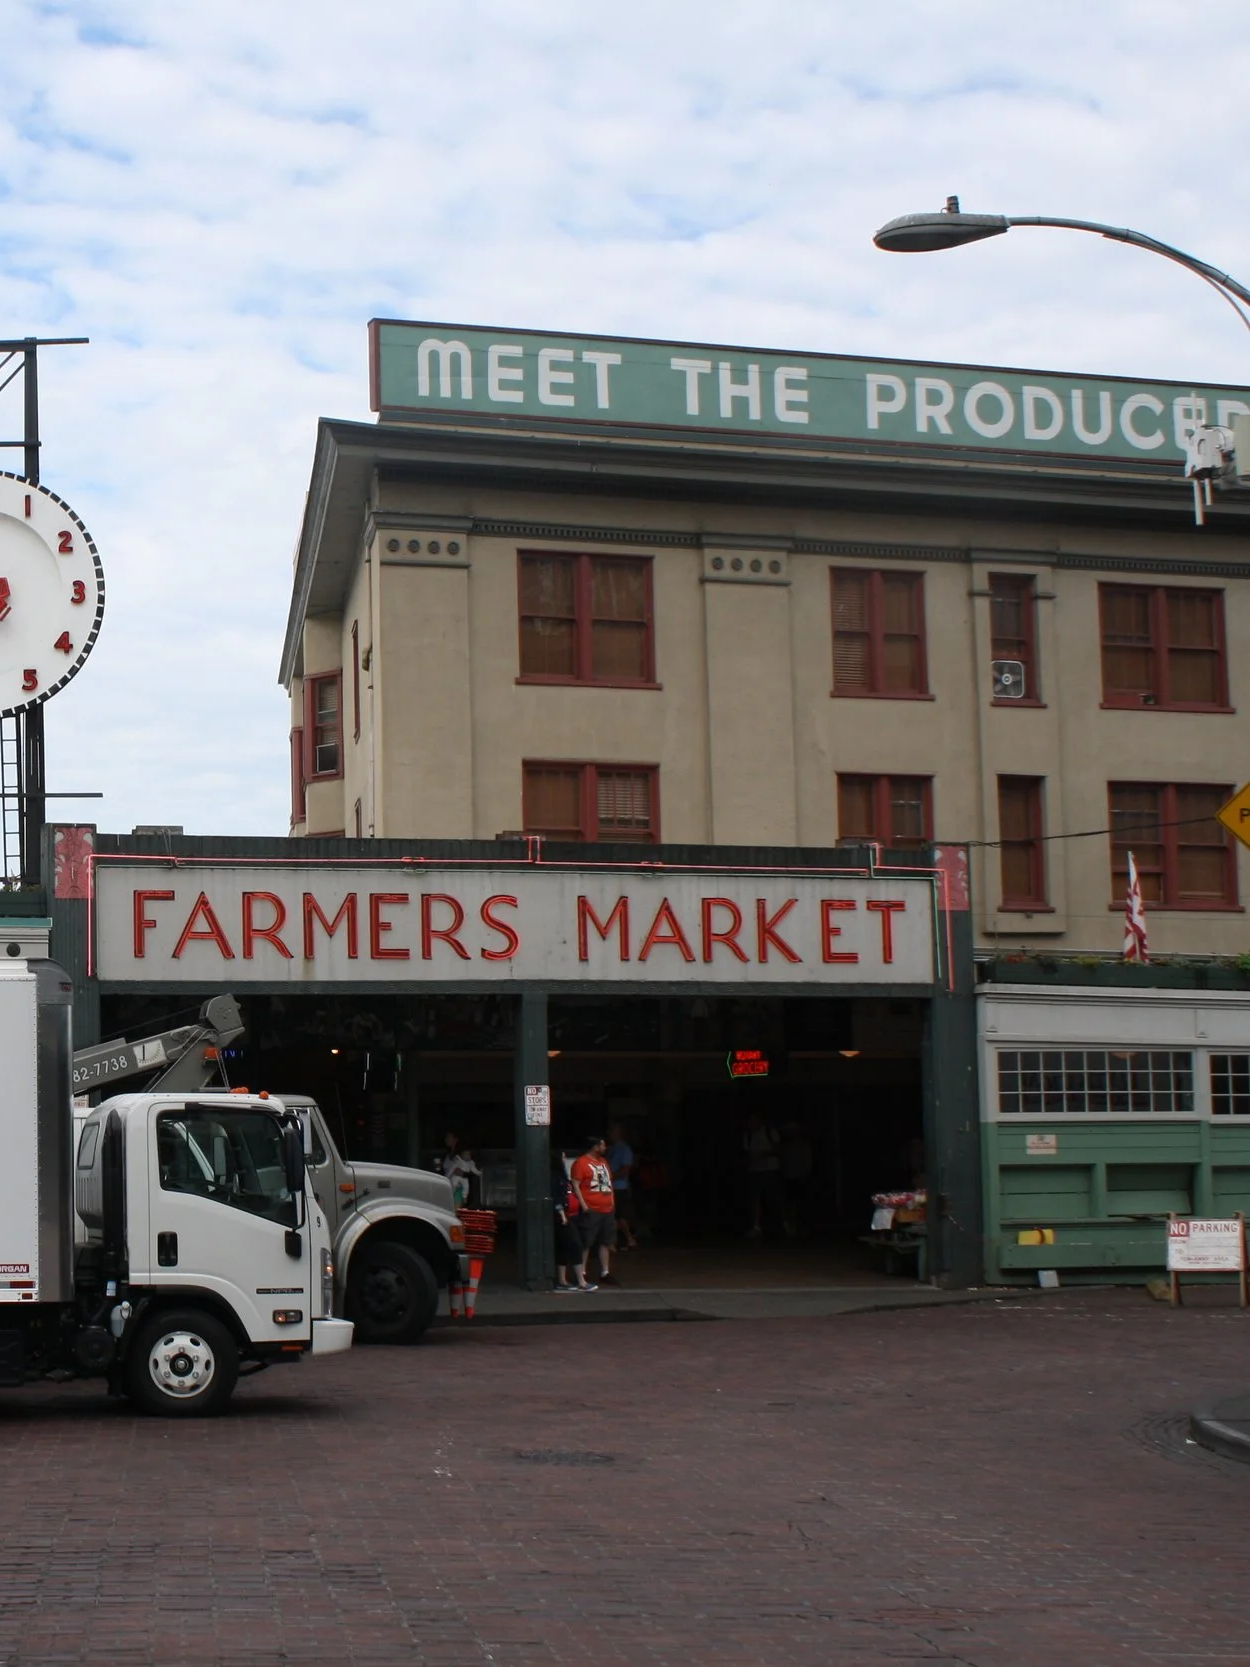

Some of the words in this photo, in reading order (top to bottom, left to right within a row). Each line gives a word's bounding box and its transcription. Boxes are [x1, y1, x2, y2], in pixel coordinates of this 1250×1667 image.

[417, 338, 622, 409] MEET
[670, 357, 810, 424] THE
[25, 495, 31, 517] 1
[58, 530, 74, 553] 2
[70, 580, 87, 604] 3
[53, 631, 74, 654] 4
[22, 669, 38, 691] 5
[133, 889, 519, 961] FARMERS
[577, 895, 906, 964] MARKET
[1169, 1223, 1188, 1235] NO
[1192, 1223, 1238, 1233] PARKING
